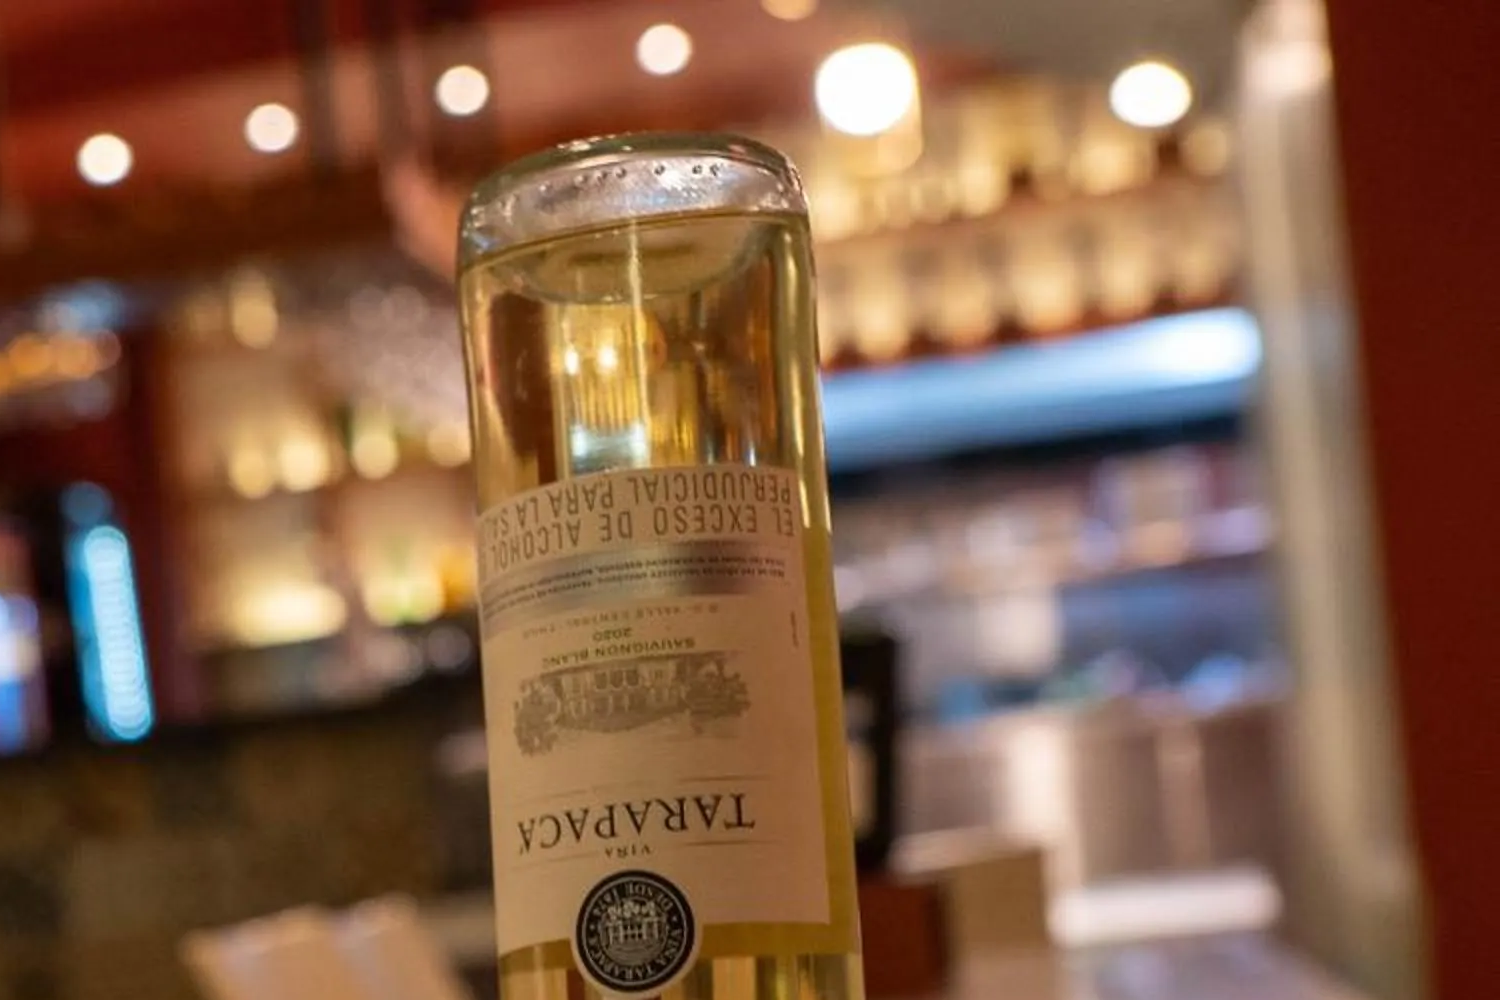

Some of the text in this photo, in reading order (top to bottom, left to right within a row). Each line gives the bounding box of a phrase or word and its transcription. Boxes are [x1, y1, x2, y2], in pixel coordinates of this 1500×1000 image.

[549, 480, 613, 518] PARA
[630, 473, 791, 506] PERJUDICIAL
[515, 497, 539, 526] LA
[598, 511, 632, 543] DE
[653, 504, 757, 536] EXCESO
[772, 507, 794, 537] EL
[490, 517, 582, 572] ALCOHOL
[592, 626, 633, 643] 2020
[541, 637, 696, 670] SAUVIGNON BLANC
[518, 794, 755, 857] TARAPACÁ
[604, 843, 653, 860] VIÑA
